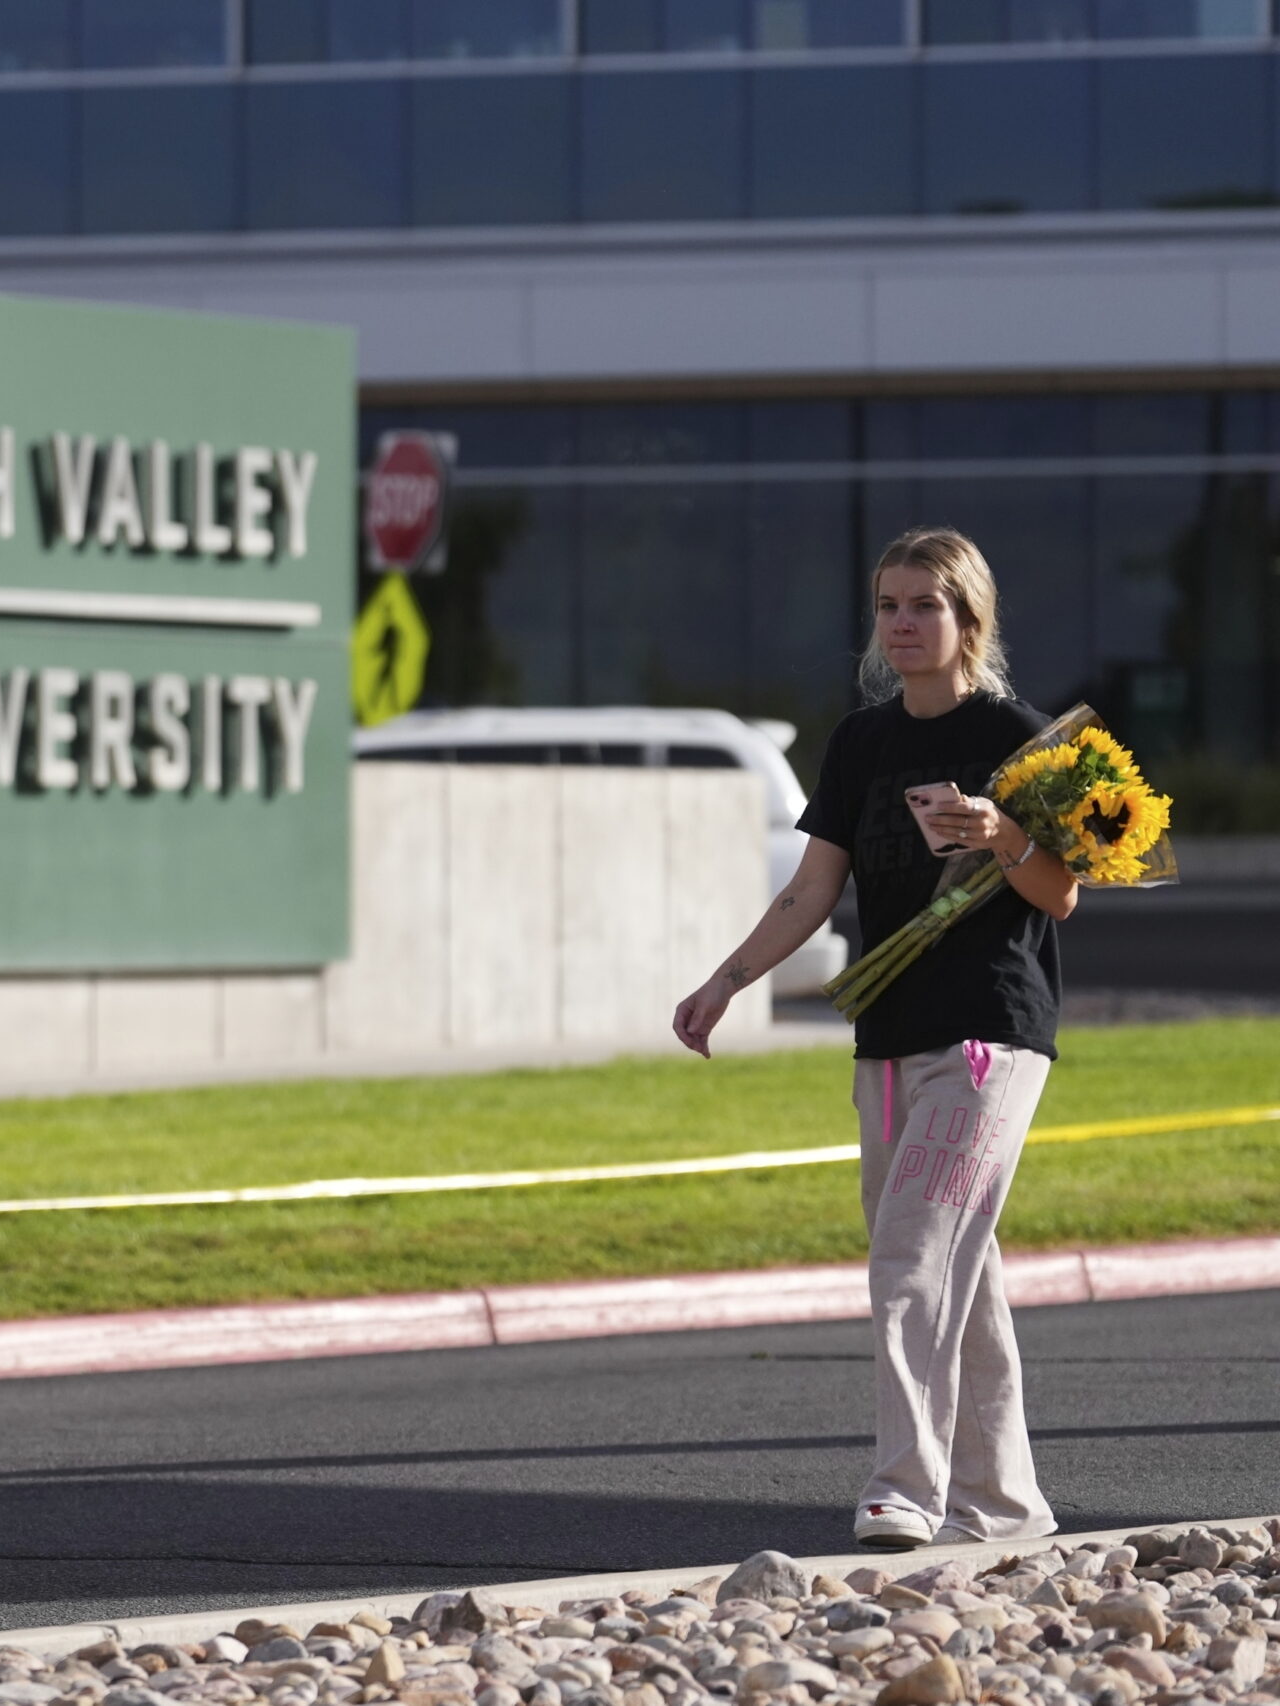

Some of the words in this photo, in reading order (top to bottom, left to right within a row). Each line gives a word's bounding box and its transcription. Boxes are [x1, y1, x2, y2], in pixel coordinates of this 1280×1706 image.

[51, 430, 318, 559] VALLEY
[368, 473, 440, 528] STOP
[925, 1105, 1007, 1155] LOVE
[891, 1145, 1002, 1216] PINK
